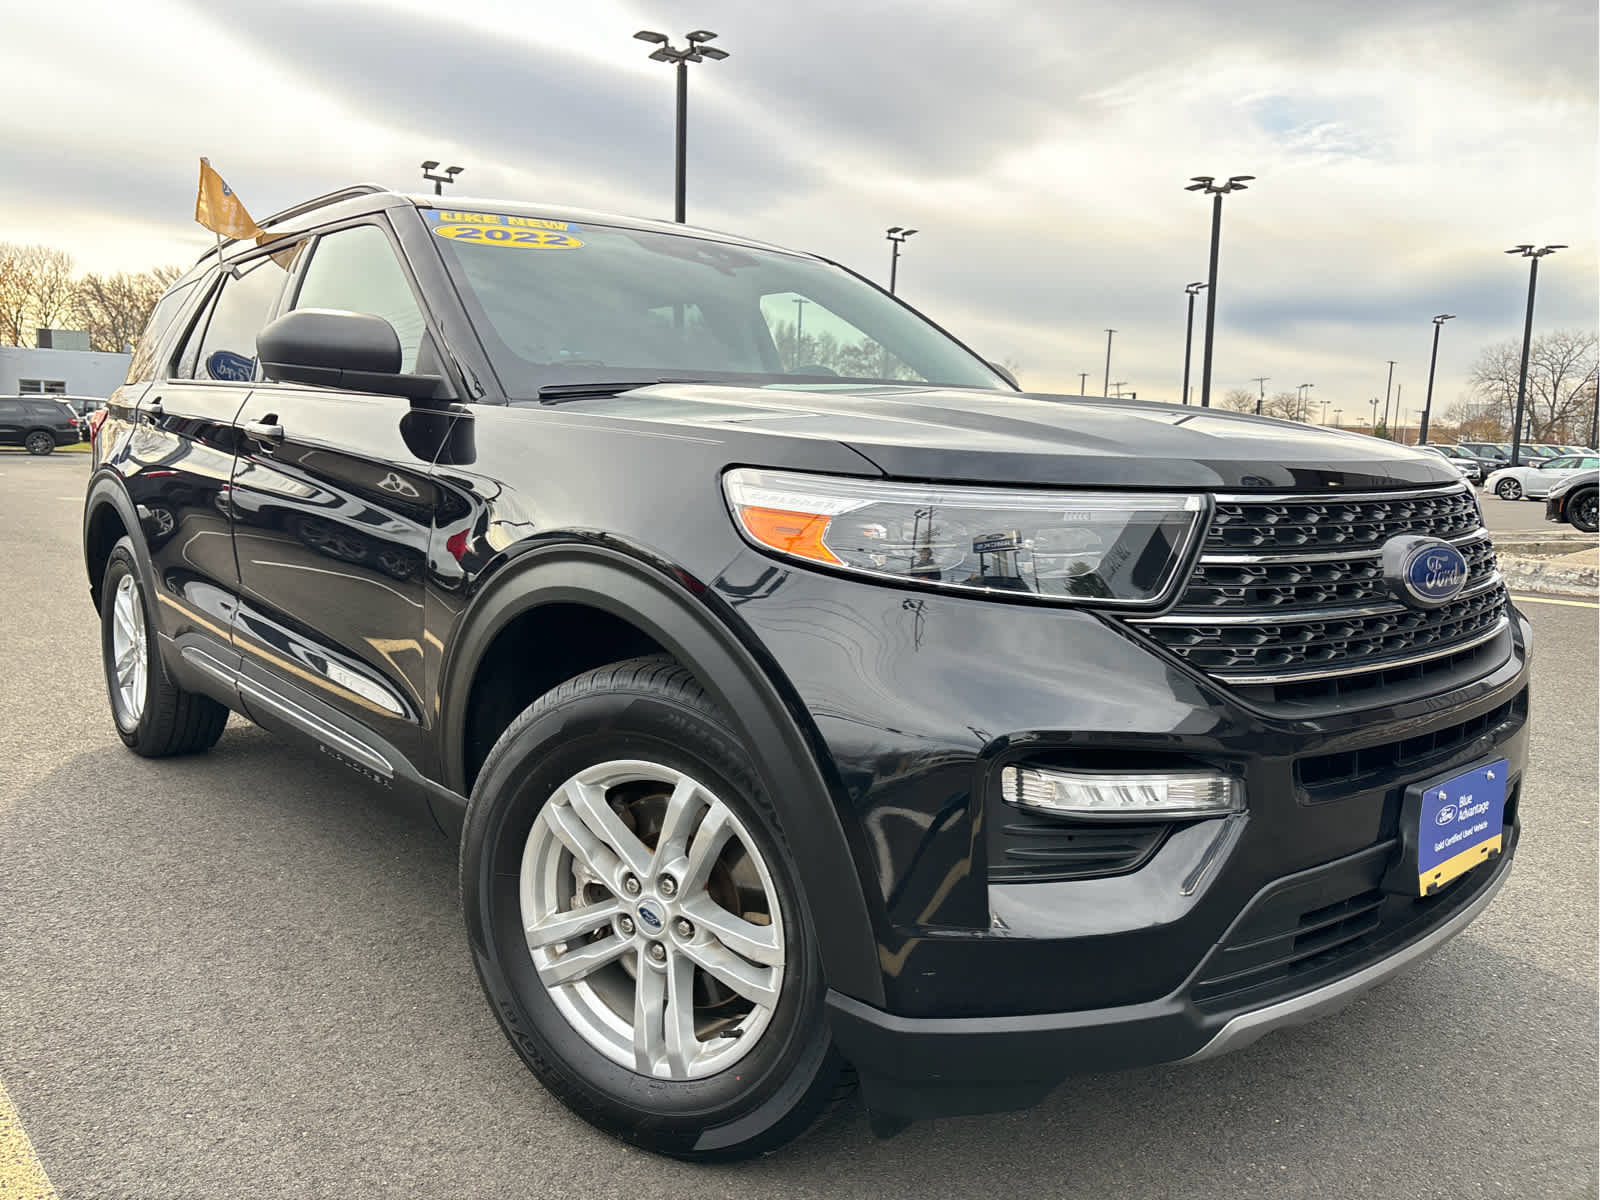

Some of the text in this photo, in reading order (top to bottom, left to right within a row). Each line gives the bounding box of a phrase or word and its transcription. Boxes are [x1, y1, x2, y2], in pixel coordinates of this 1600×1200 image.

[440, 211, 501, 225] LIKE
[454, 227, 569, 246] 2022
[1426, 556, 1459, 589] Ford
[1459, 794, 1473, 808] Blue
[1439, 807, 1454, 822] Ford
[1458, 801, 1489, 821] Advantage
